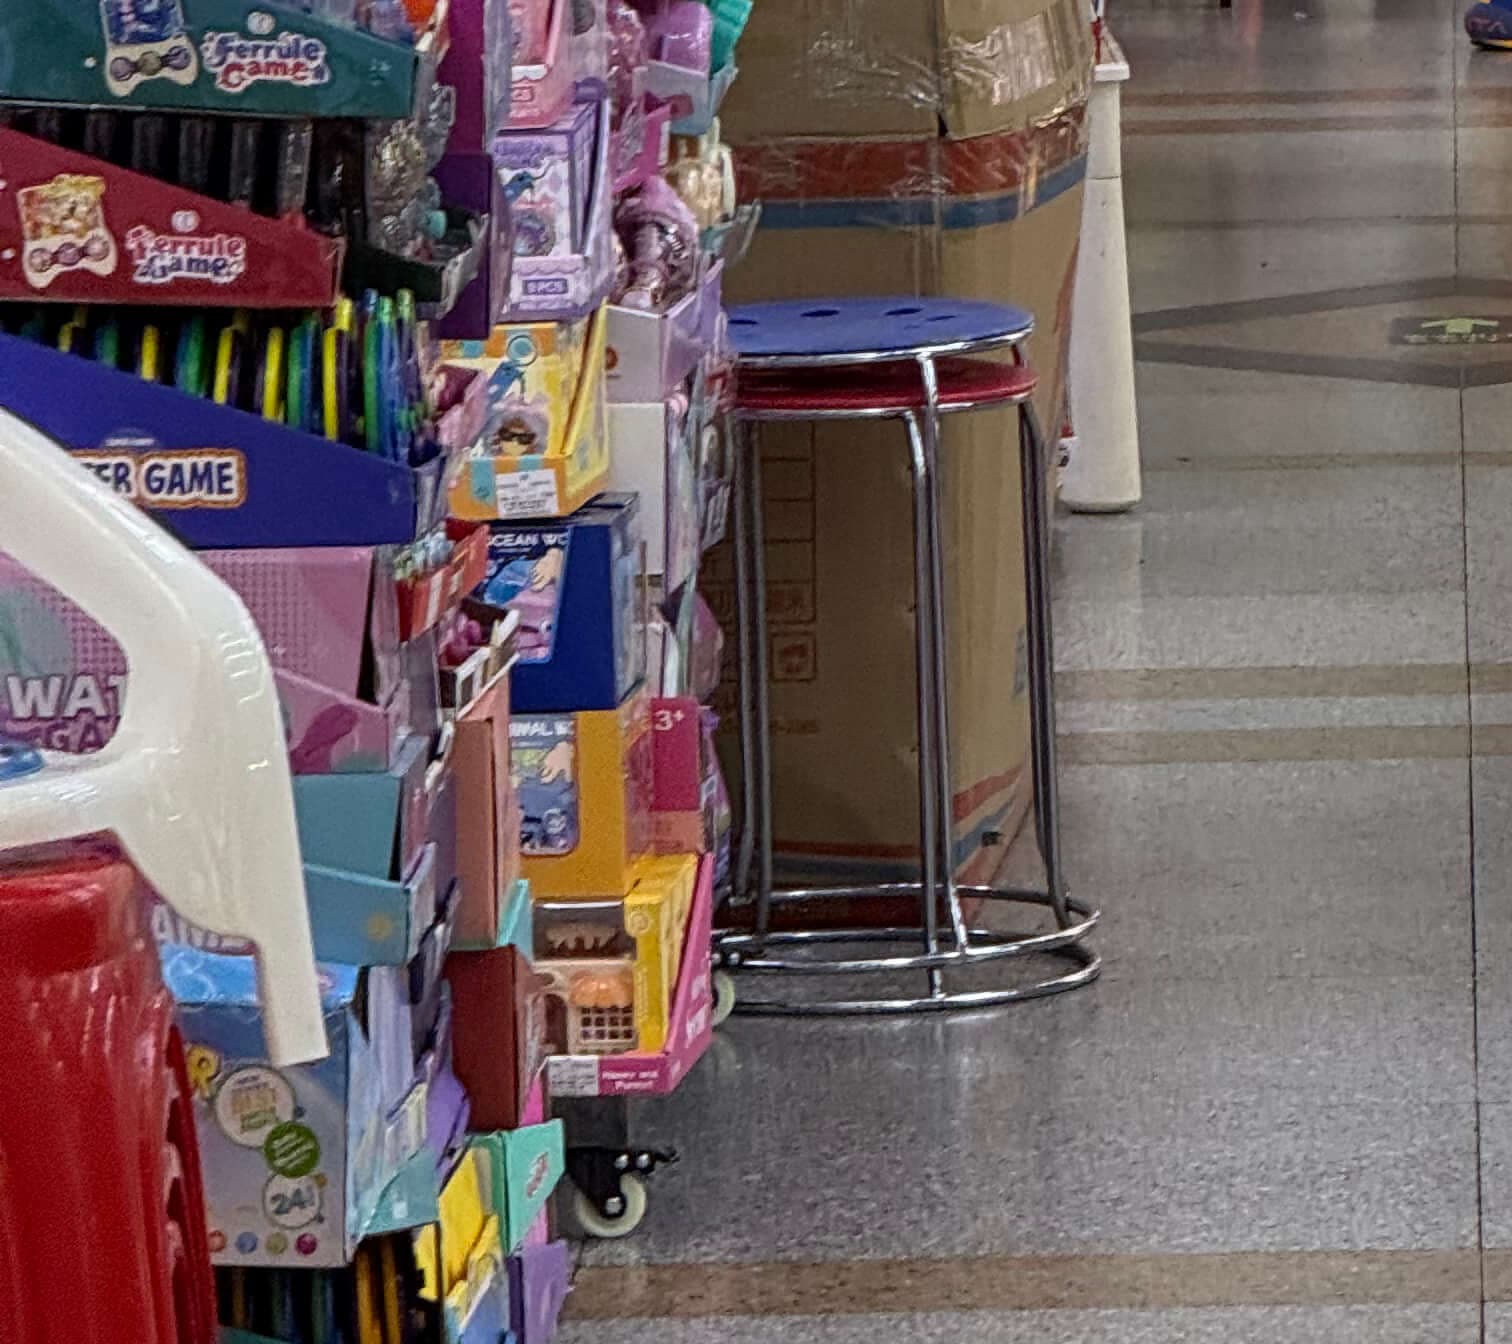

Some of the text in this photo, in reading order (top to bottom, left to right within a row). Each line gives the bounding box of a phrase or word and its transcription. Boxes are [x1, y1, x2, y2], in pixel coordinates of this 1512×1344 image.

[144, 461, 235, 495] GAME
[7, 674, 128, 719] WAT
[654, 708, 685, 731] 3+
